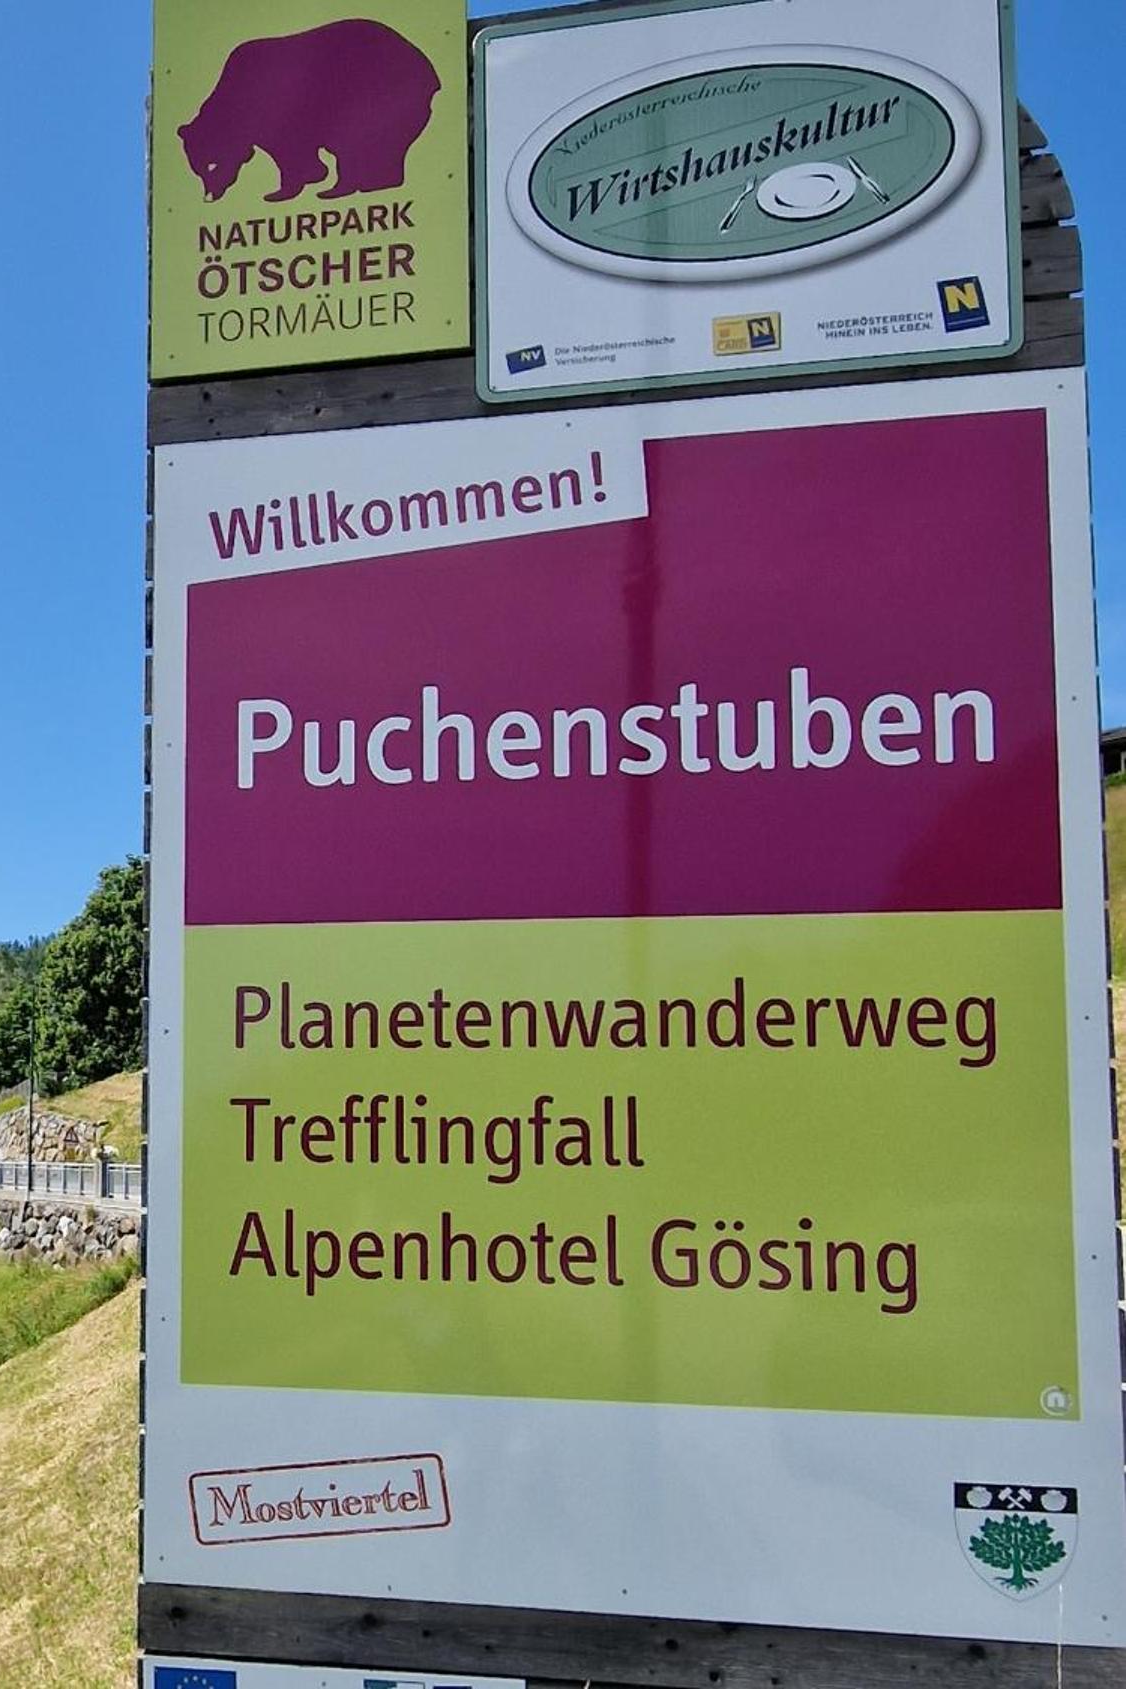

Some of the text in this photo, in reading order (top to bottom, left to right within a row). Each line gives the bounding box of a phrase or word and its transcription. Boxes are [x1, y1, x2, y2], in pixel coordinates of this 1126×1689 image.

[567, 96, 900, 222] Wirtshauskultur
[199, 201, 415, 252] NATURPARK
[198, 243, 415, 299] ÖTSCHER
[944, 282, 980, 313] N
[198, 292, 415, 343] TORMÄUER
[817, 312, 933, 331] NIEDERÖSTERREICH
[825, 327, 866, 340] HINEIN
[869, 325, 889, 336] INS
[520, 349, 541, 362] NV
[554, 336, 676, 356] Die Niederösterreichische
[555, 353, 616, 367] Versicherung
[209, 451, 607, 560] Willkommen!
[237, 667, 995, 789] Puchenstuben
[235, 977, 997, 1068] Planetenwanderweg
[229, 1094, 645, 1184] Trefflingfall
[229, 1208, 918, 1314] Alpenhotel Gösing
[207, 1469, 432, 1526] Mostviertel
